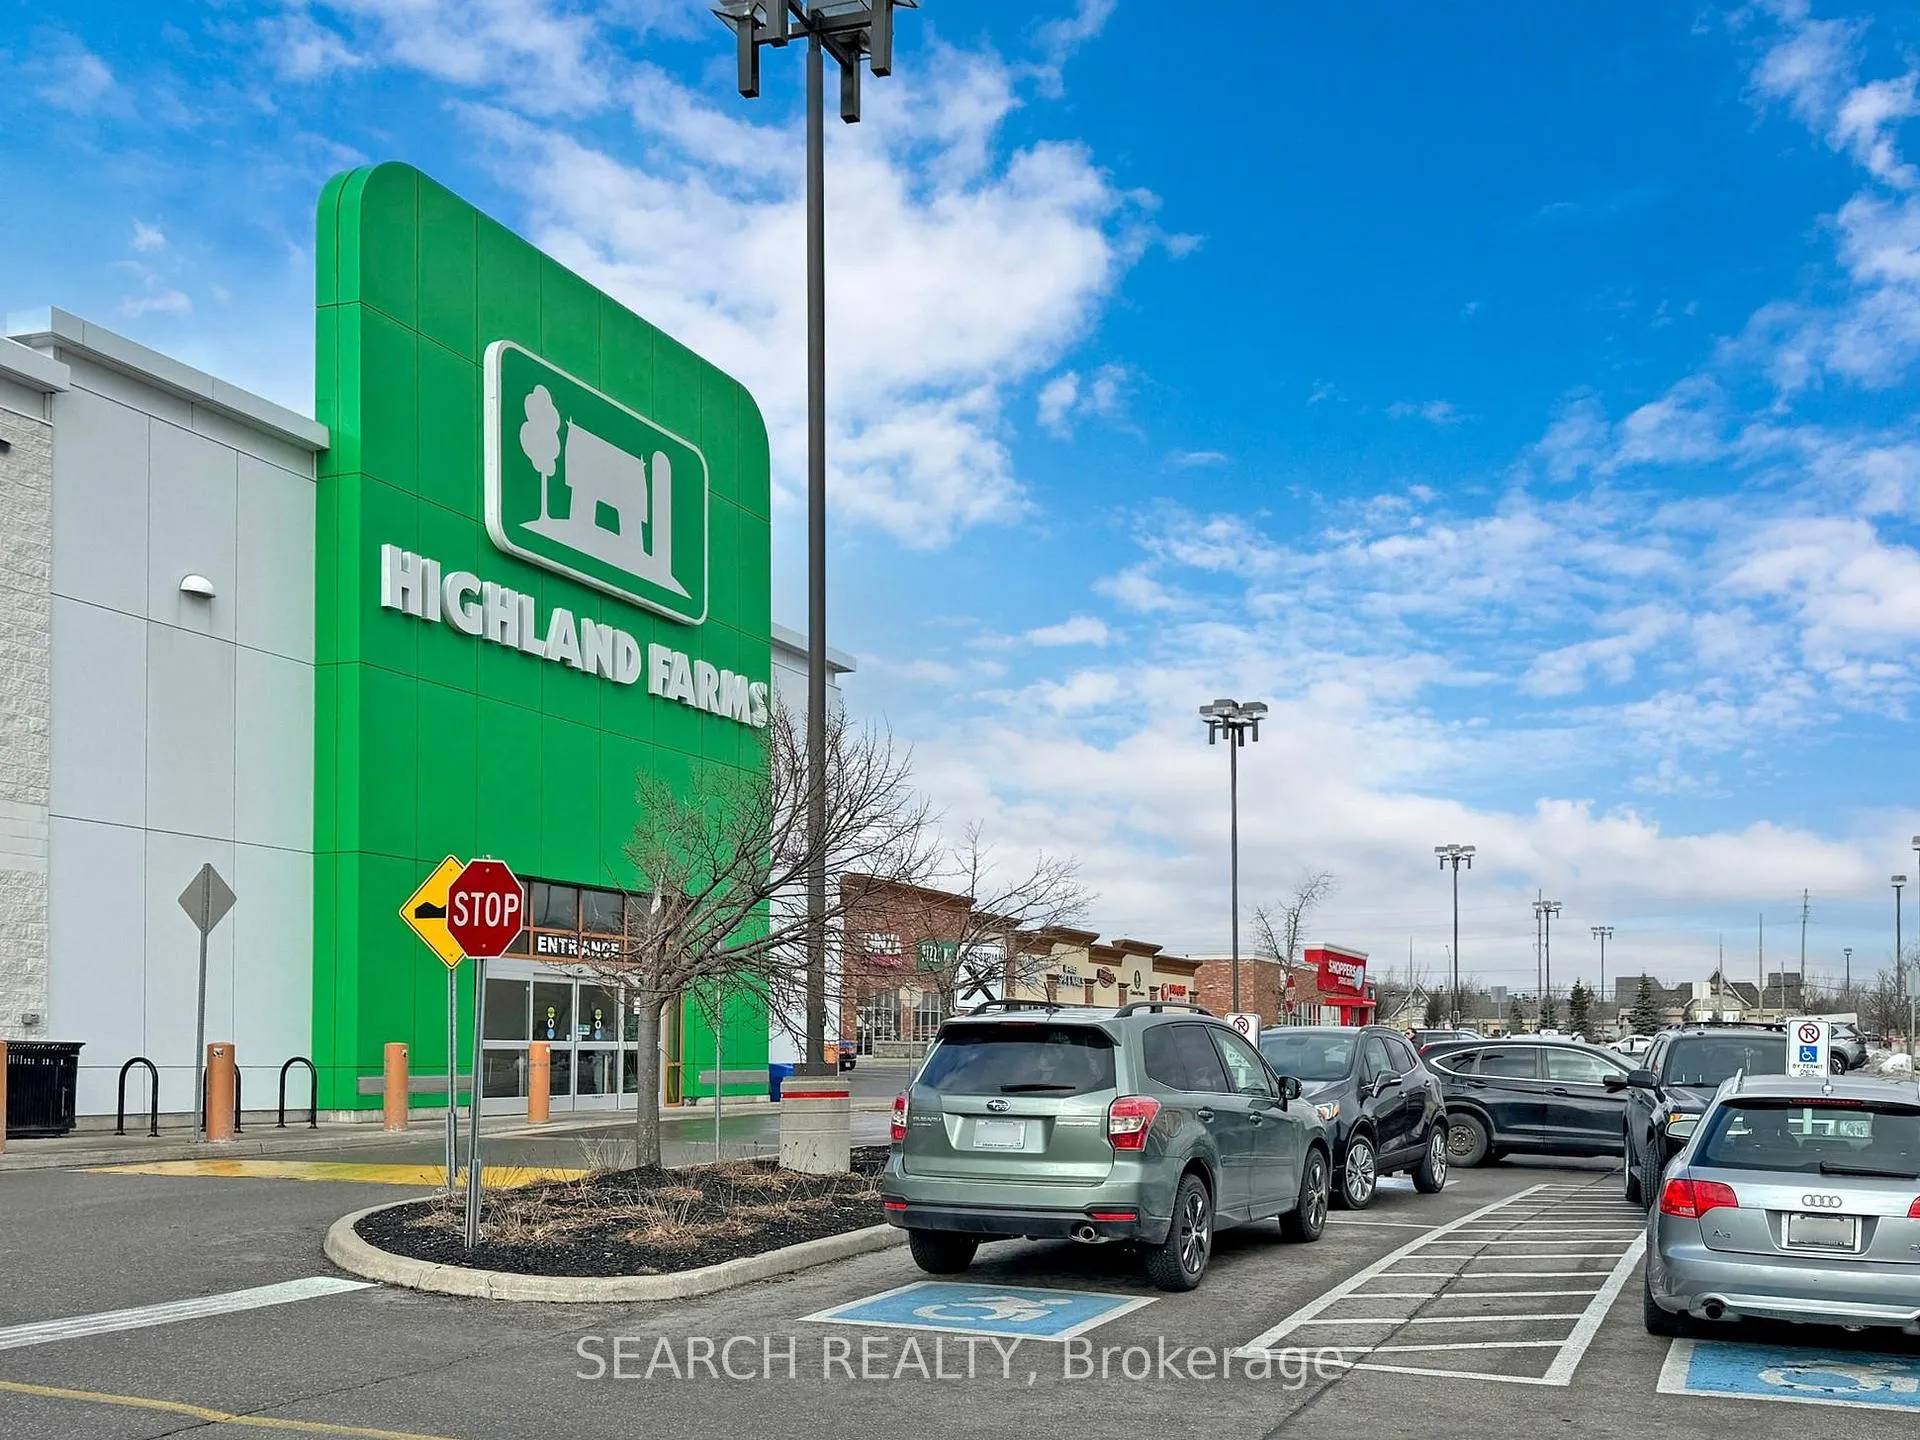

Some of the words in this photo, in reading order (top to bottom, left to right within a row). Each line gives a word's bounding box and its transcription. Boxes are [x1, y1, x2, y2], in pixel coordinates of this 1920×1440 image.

[381, 544, 641, 684] HIGHLAND
[648, 643, 768, 729] FARMS
[453, 891, 519, 927] STOP
[537, 935, 620, 959] ENTRANCE
[1328, 959, 1357, 978] SHOPPERS
